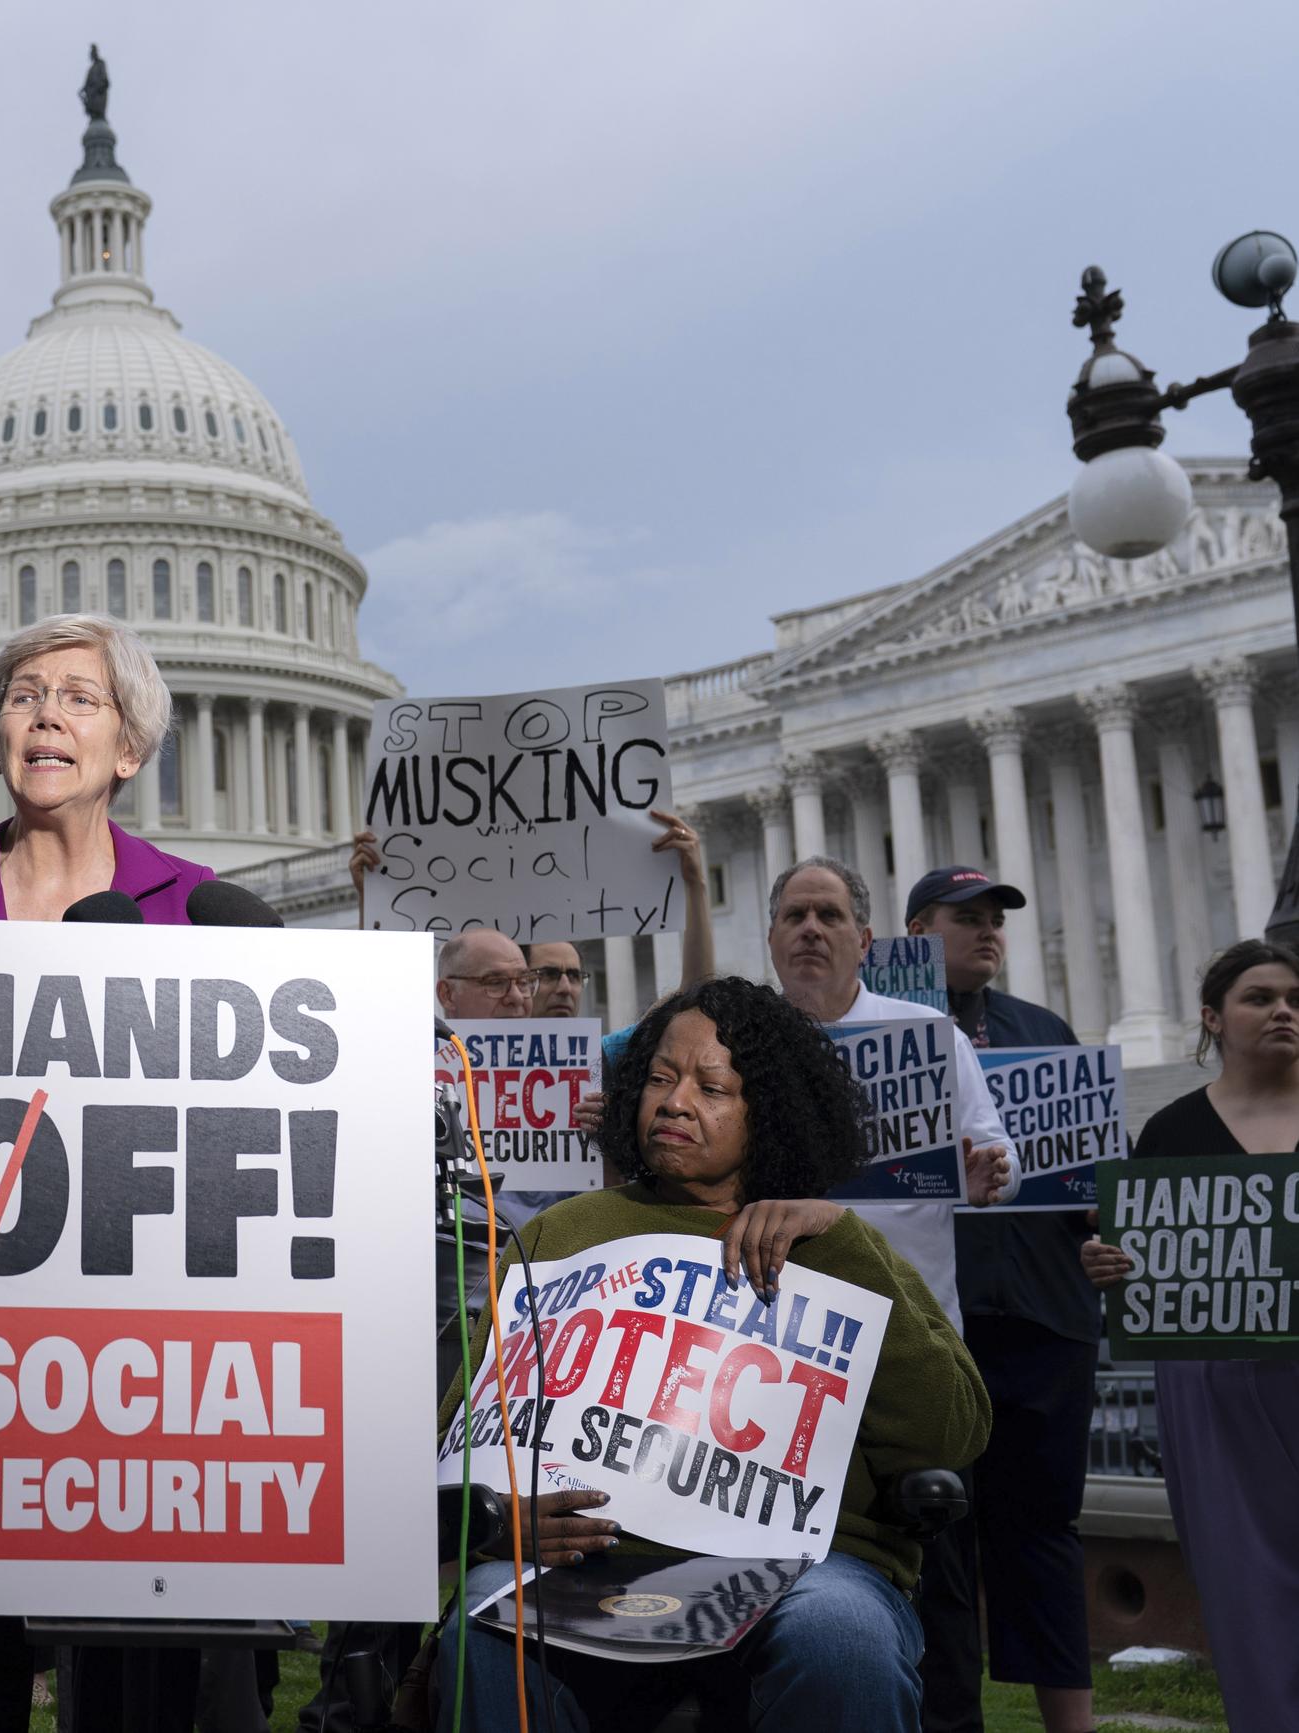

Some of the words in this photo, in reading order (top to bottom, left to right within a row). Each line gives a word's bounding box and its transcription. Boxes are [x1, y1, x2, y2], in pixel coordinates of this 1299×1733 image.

[384, 690, 649, 753] STOP
[366, 738, 666, 826] MUSKING
[379, 825, 590, 882] Social
[889, 937, 931, 966] AND
[465, 1034, 589, 1068] STEAL!!
[435, 1069, 591, 1130] TECT
[986, 1050, 1116, 1110] SOCIAL
[1002, 1088, 1119, 1140] ECURITY.
[465, 1130, 596, 1163] SECURITY.
[1016, 1121, 1120, 1174] MONEY!
[1114, 1173, 1274, 1228] HANDS
[1120, 1226, 1284, 1281] SOCIAL
[508, 1262, 606, 1334] STOP
[593, 1260, 643, 1301] THE
[634, 1256, 864, 1374] STEAL!!
[470, 1307, 849, 1481] PROTECT
[439, 1398, 556, 1462] SOCIAL
[571, 1405, 826, 1536] SECURITY.
